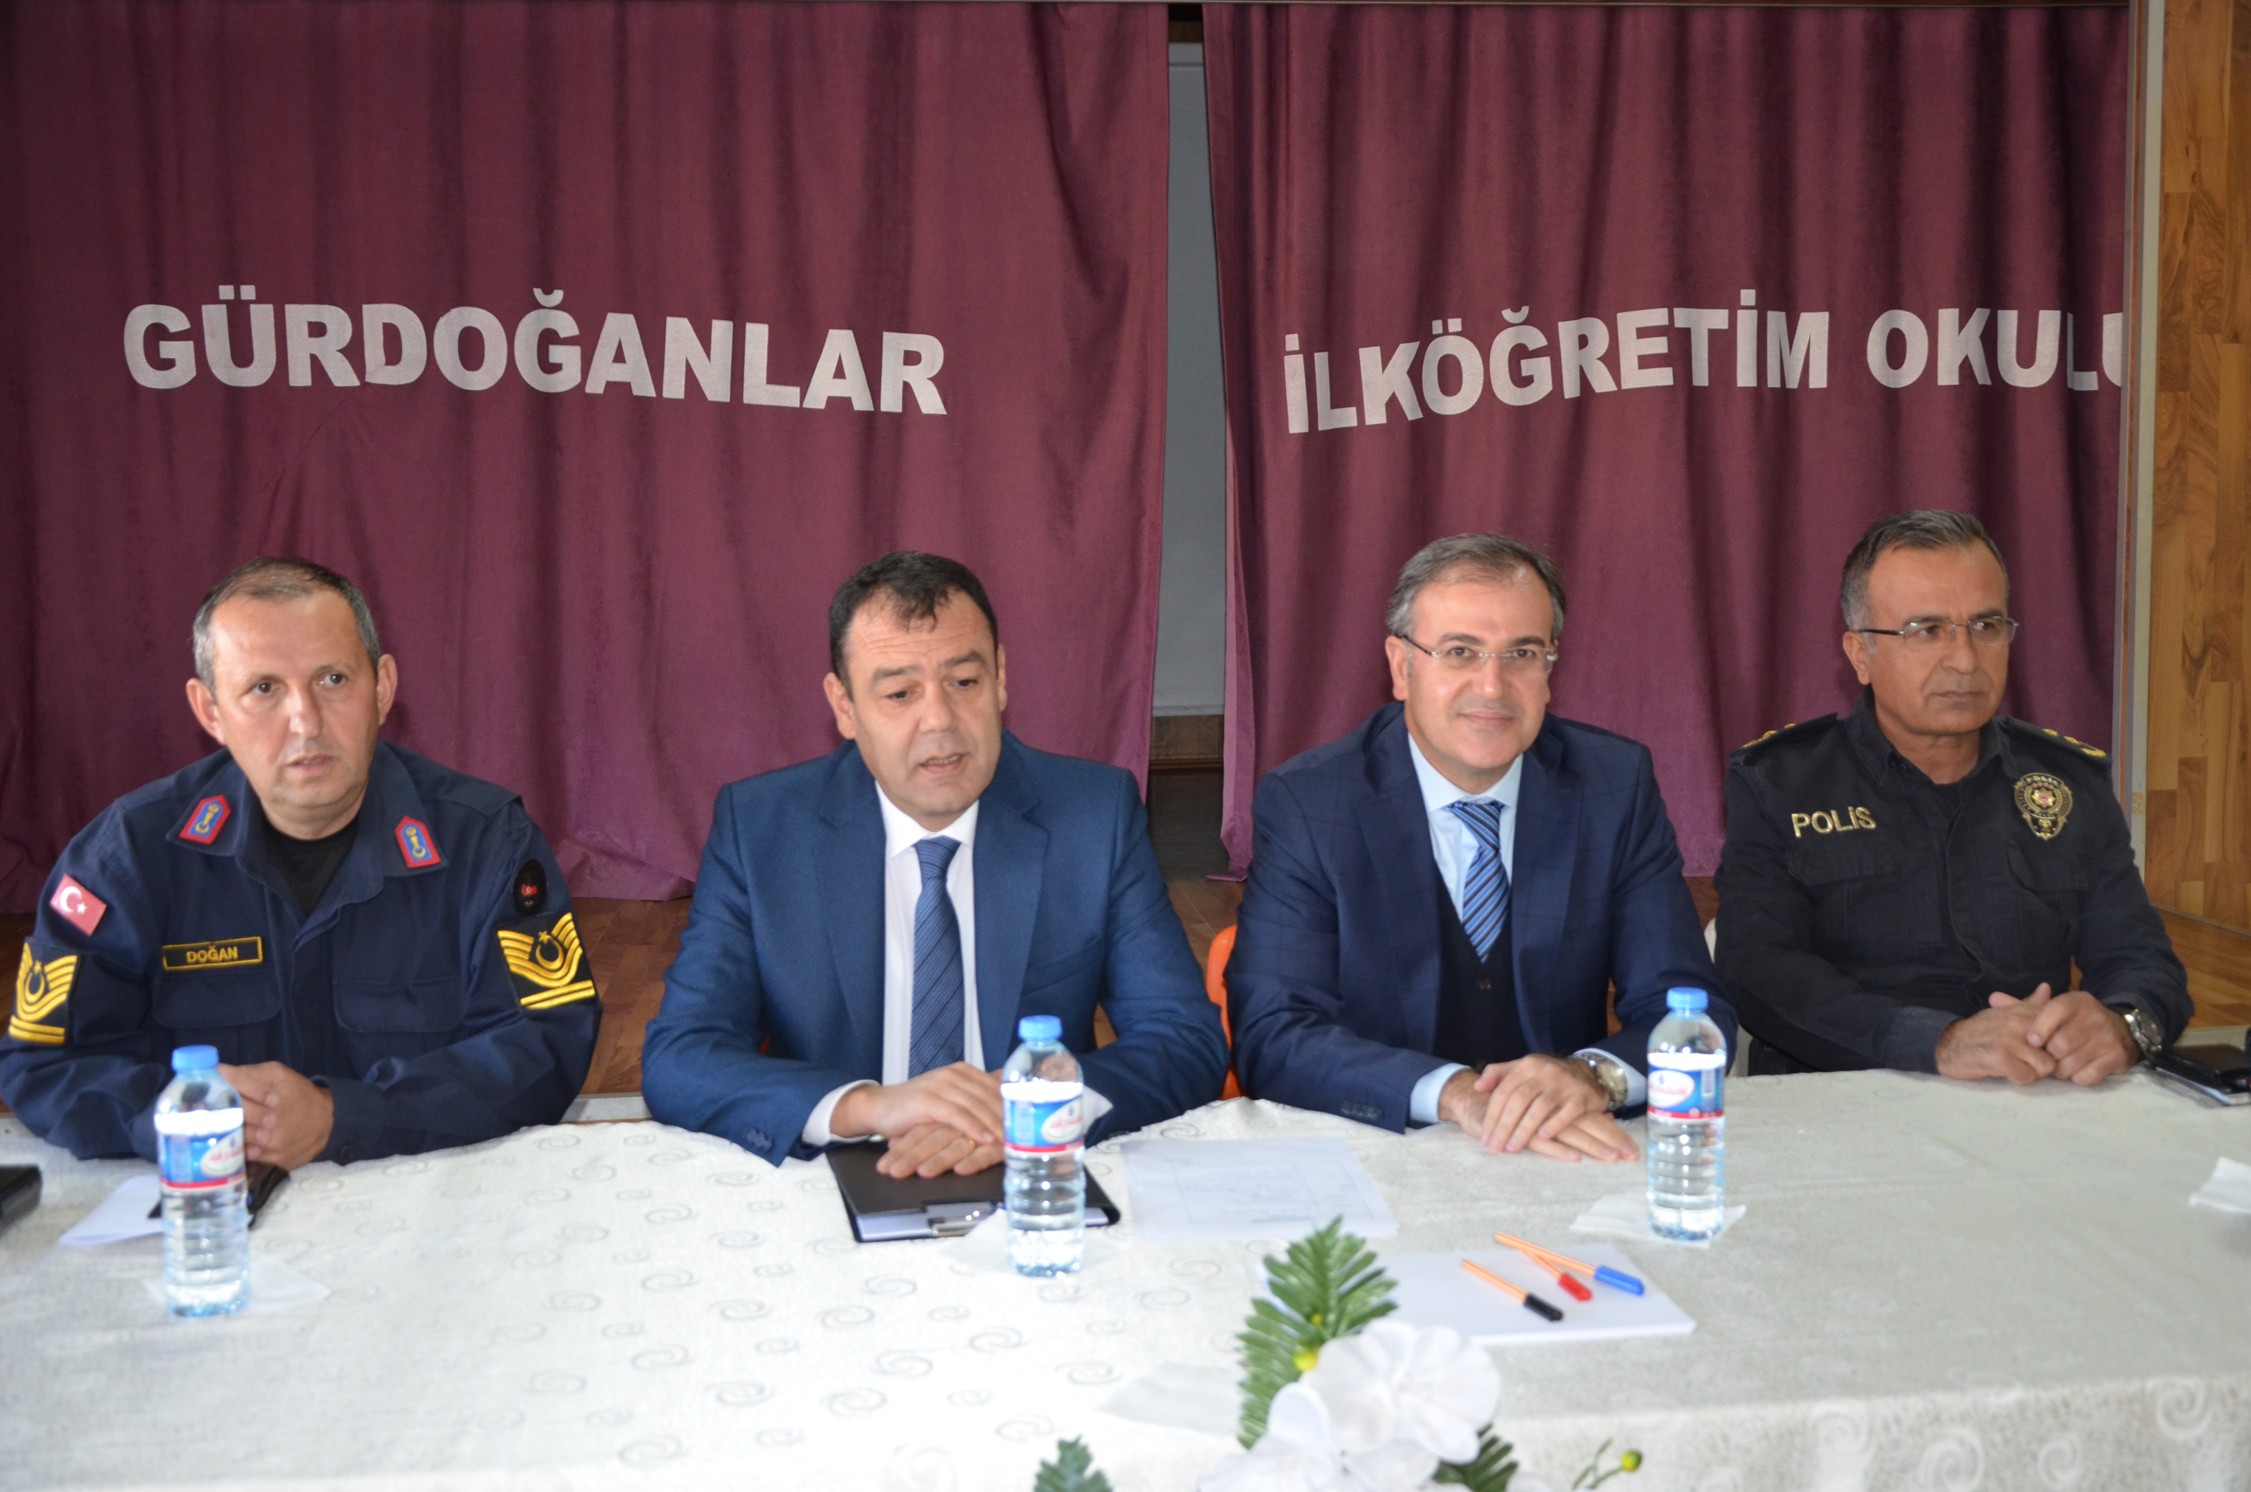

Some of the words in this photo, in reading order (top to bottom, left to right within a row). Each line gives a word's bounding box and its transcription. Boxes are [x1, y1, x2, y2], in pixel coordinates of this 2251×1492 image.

[124, 285, 948, 414] GÜRDOĞANLAR
[1284, 289, 1829, 433] İLKÖĞRETİM
[1791, 806, 1876, 838] POLİS
[186, 945, 238, 963] DOĞAN
